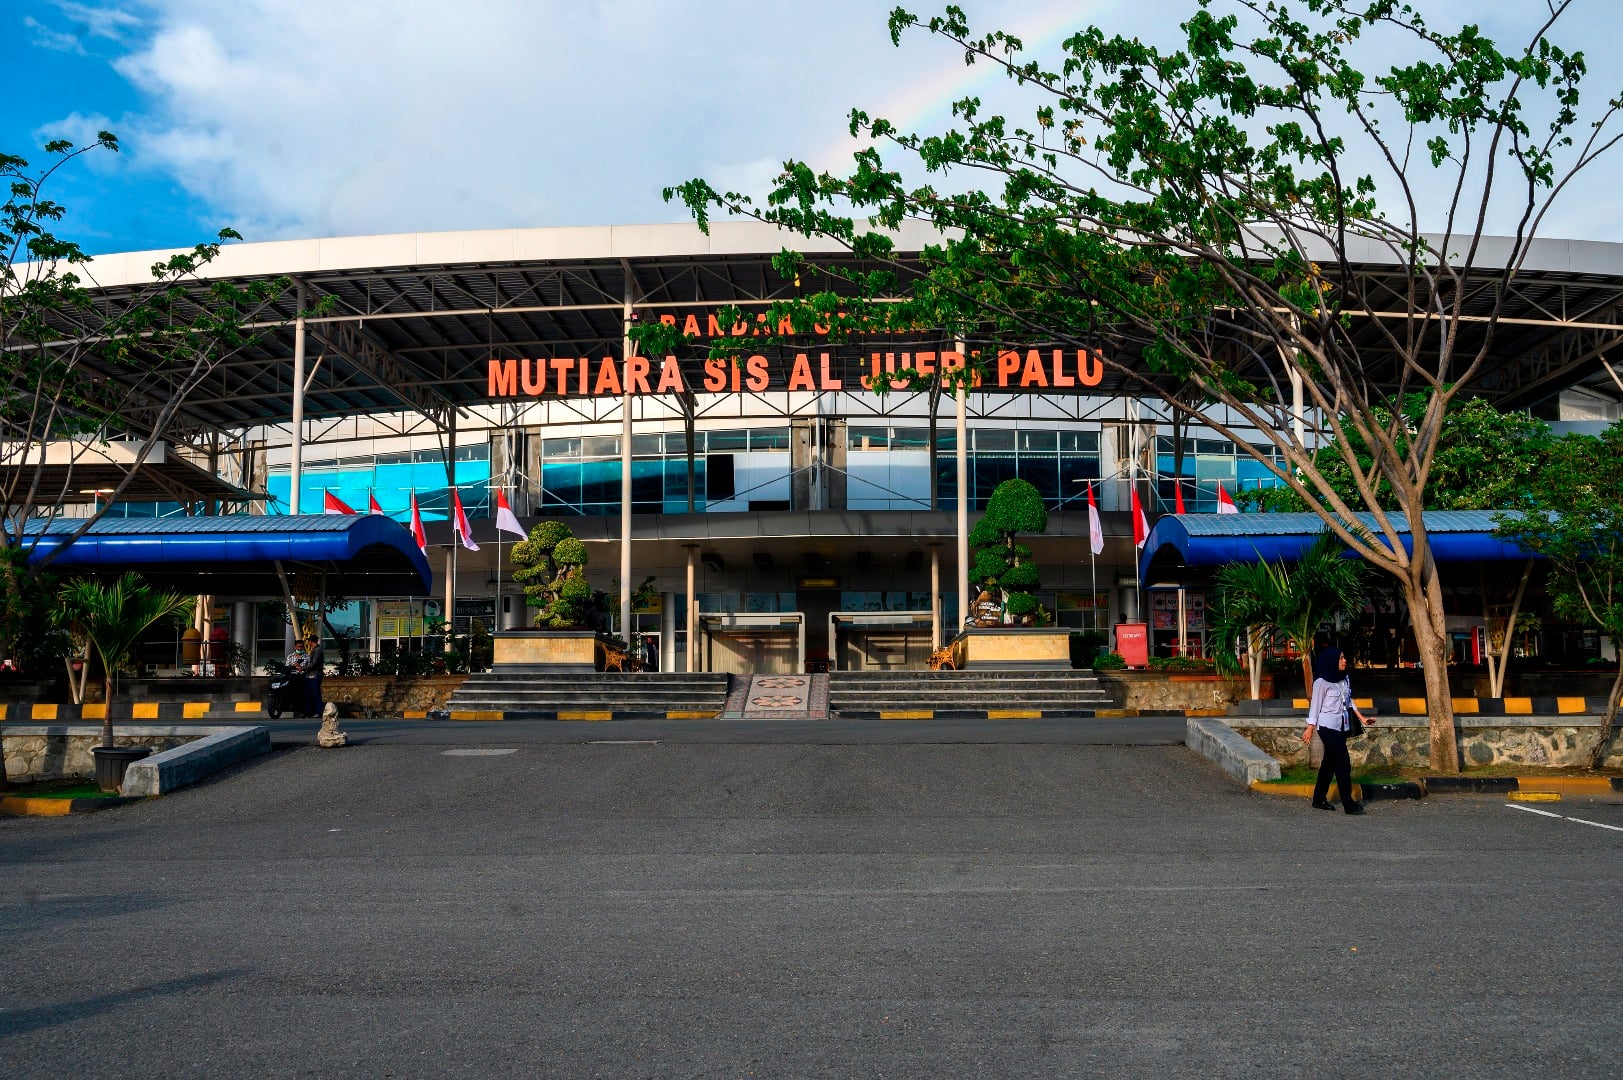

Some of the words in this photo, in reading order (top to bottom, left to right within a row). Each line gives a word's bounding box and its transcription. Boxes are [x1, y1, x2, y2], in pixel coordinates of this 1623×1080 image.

[488, 356, 685, 396] MUTIARA
[704, 354, 769, 392] SIS
[788, 353, 842, 391] AL
[998, 349, 1103, 387] PALU
